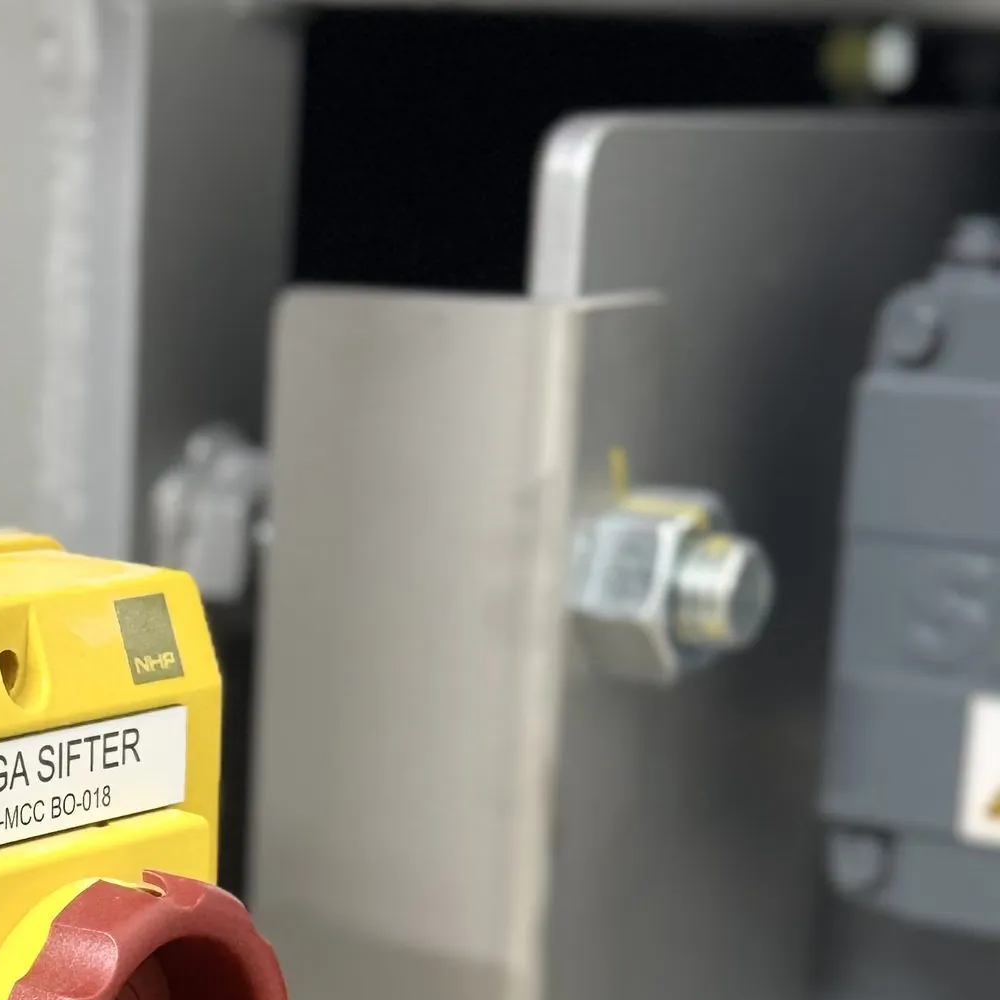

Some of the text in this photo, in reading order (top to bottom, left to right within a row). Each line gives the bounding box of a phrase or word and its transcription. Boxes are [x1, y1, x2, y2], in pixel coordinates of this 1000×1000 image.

[133, 651, 176, 674] NHP
[37, 727, 142, 783] SIFTER
[50, 785, 112, 820] BO-018
